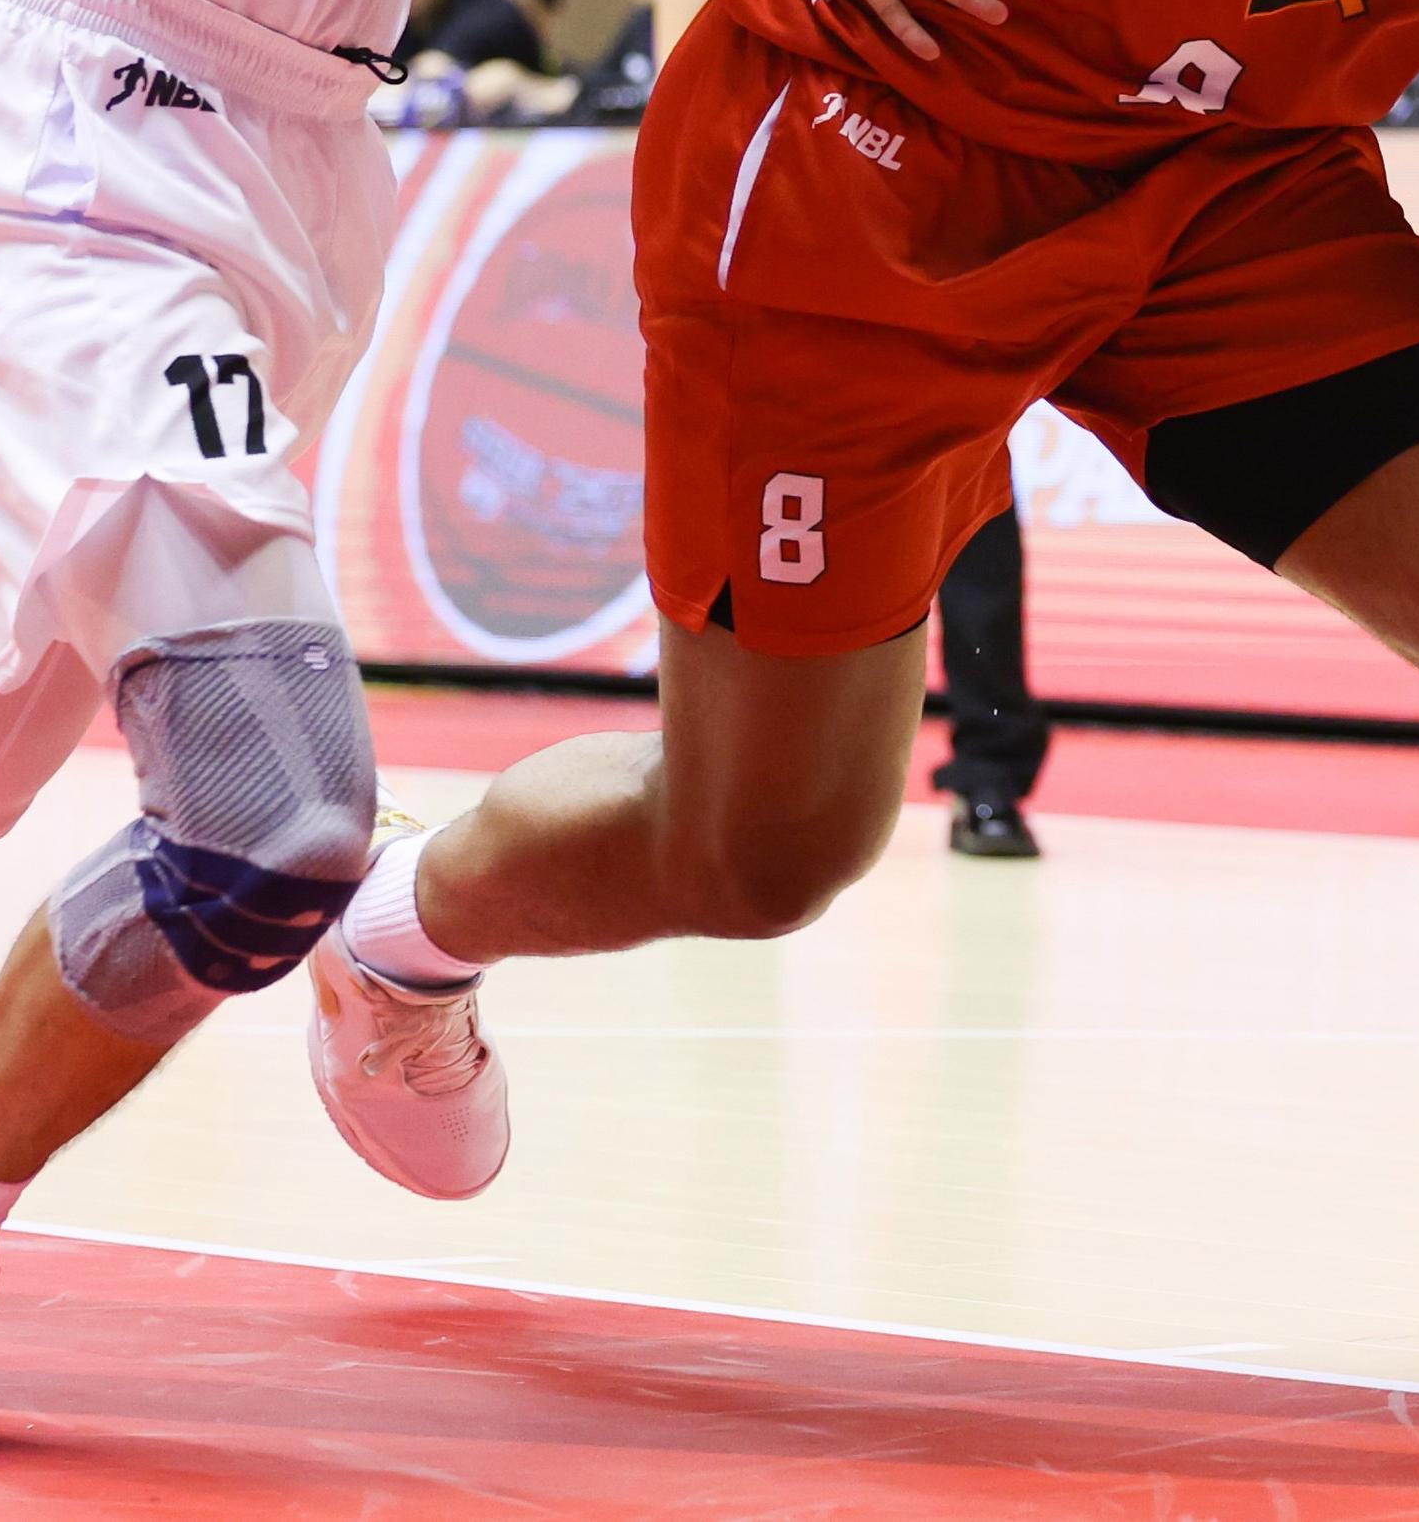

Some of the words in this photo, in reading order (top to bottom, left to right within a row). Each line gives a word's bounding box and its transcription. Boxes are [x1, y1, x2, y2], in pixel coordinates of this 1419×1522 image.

[838, 112, 906, 171] NBL
[164, 354, 268, 459] 17
[759, 472, 826, 584] 8
